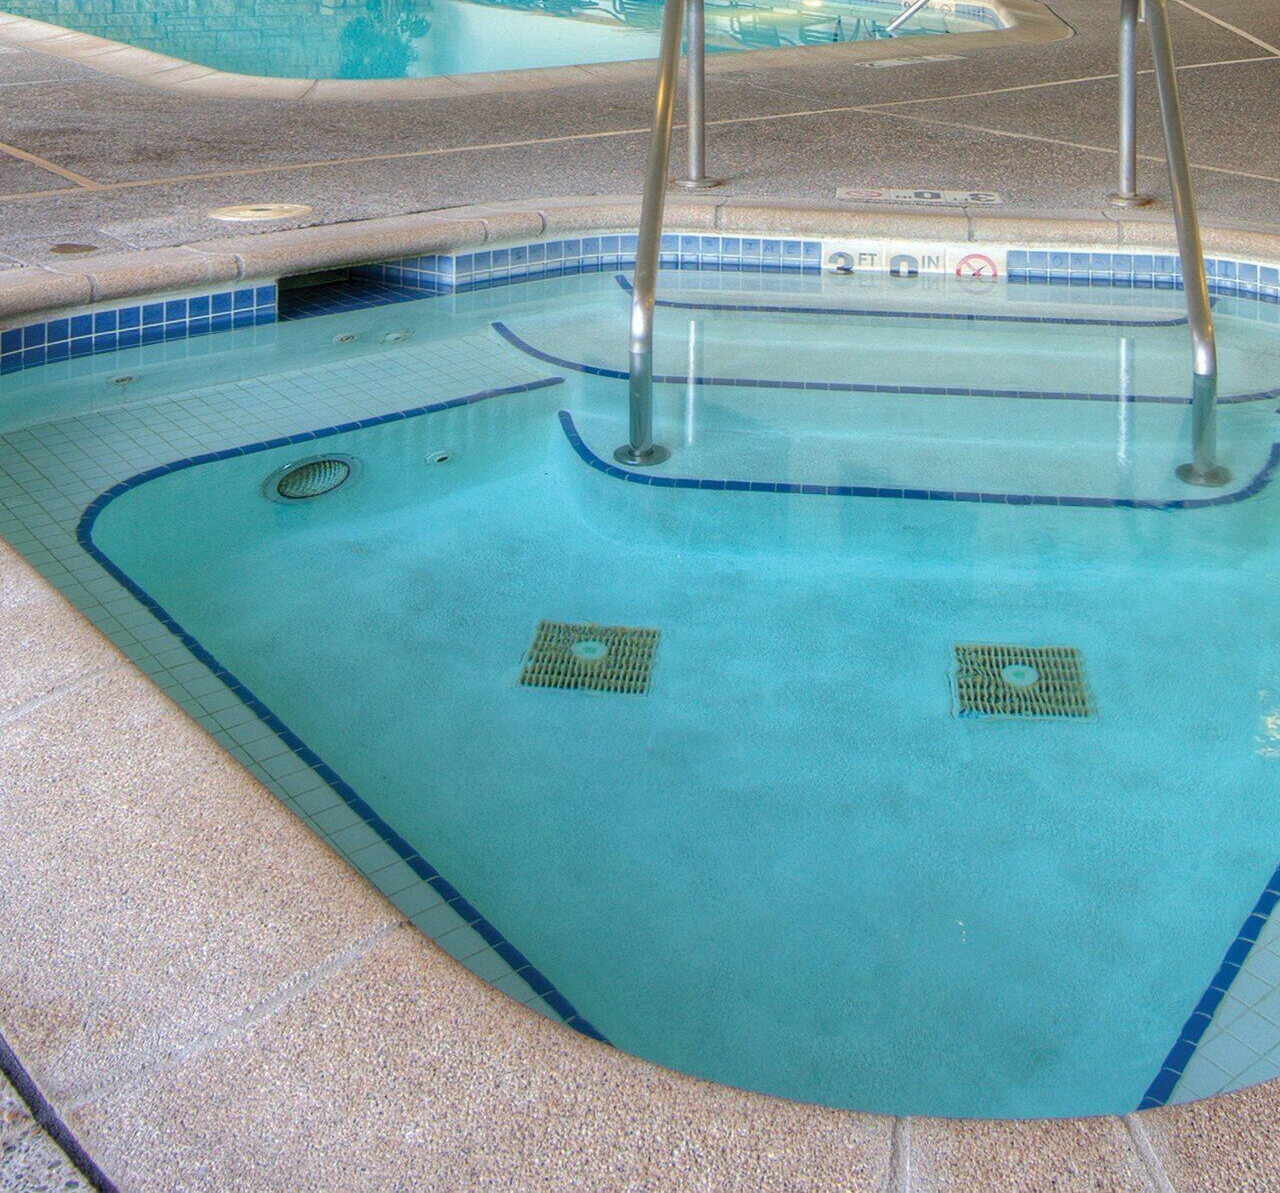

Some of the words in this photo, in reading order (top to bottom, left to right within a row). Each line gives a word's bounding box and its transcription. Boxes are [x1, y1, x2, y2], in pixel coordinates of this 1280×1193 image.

[828, 251, 855, 275] 3
[858, 252, 878, 267] FT
[922, 255, 940, 269] IN
